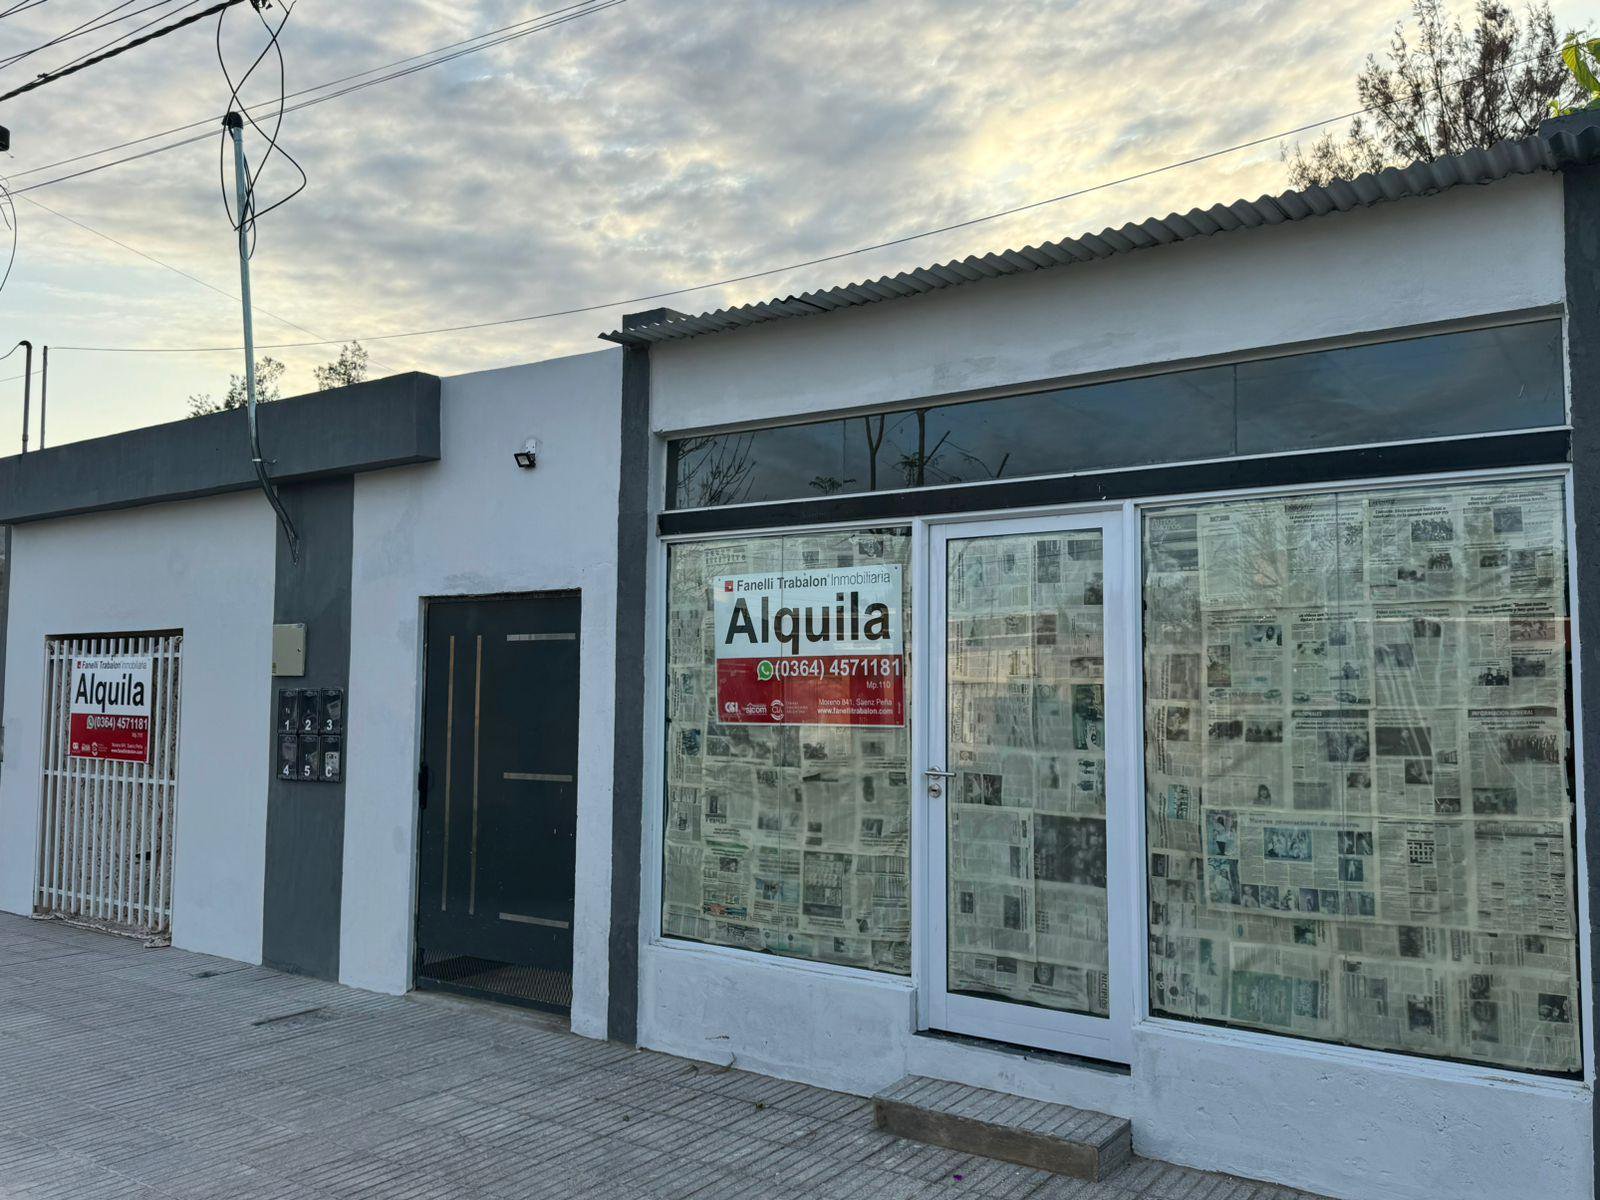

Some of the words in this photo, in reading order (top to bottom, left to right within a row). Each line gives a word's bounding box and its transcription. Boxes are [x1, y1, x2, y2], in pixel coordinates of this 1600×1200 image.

[737, 577, 774, 592] Fanelli
[776, 576, 828, 590] Trabalon
[830, 571, 891, 586] Inmobiliaria
[725, 591, 891, 655] Alquila
[82, 660, 99, 670] Fanelli
[99, 661, 121, 670] Trabalon
[774, 659, 825, 681] (0364)
[829, 659, 901, 677] 4571181
[75, 672, 145, 713] Alquila
[818, 698, 841, 706] Moreno
[876, 697, 893, 706] Peña
[817, 706, 894, 715] www.fanellitrabalon.com
[94, 716, 116, 730] (0364)
[117, 717, 148, 730] 4571181
[285, 720, 290, 731] 1
[305, 720, 311, 731] 2
[327, 720, 333, 731] 3
[283, 765, 290, 776] 4
[304, 766, 311, 776] 5
